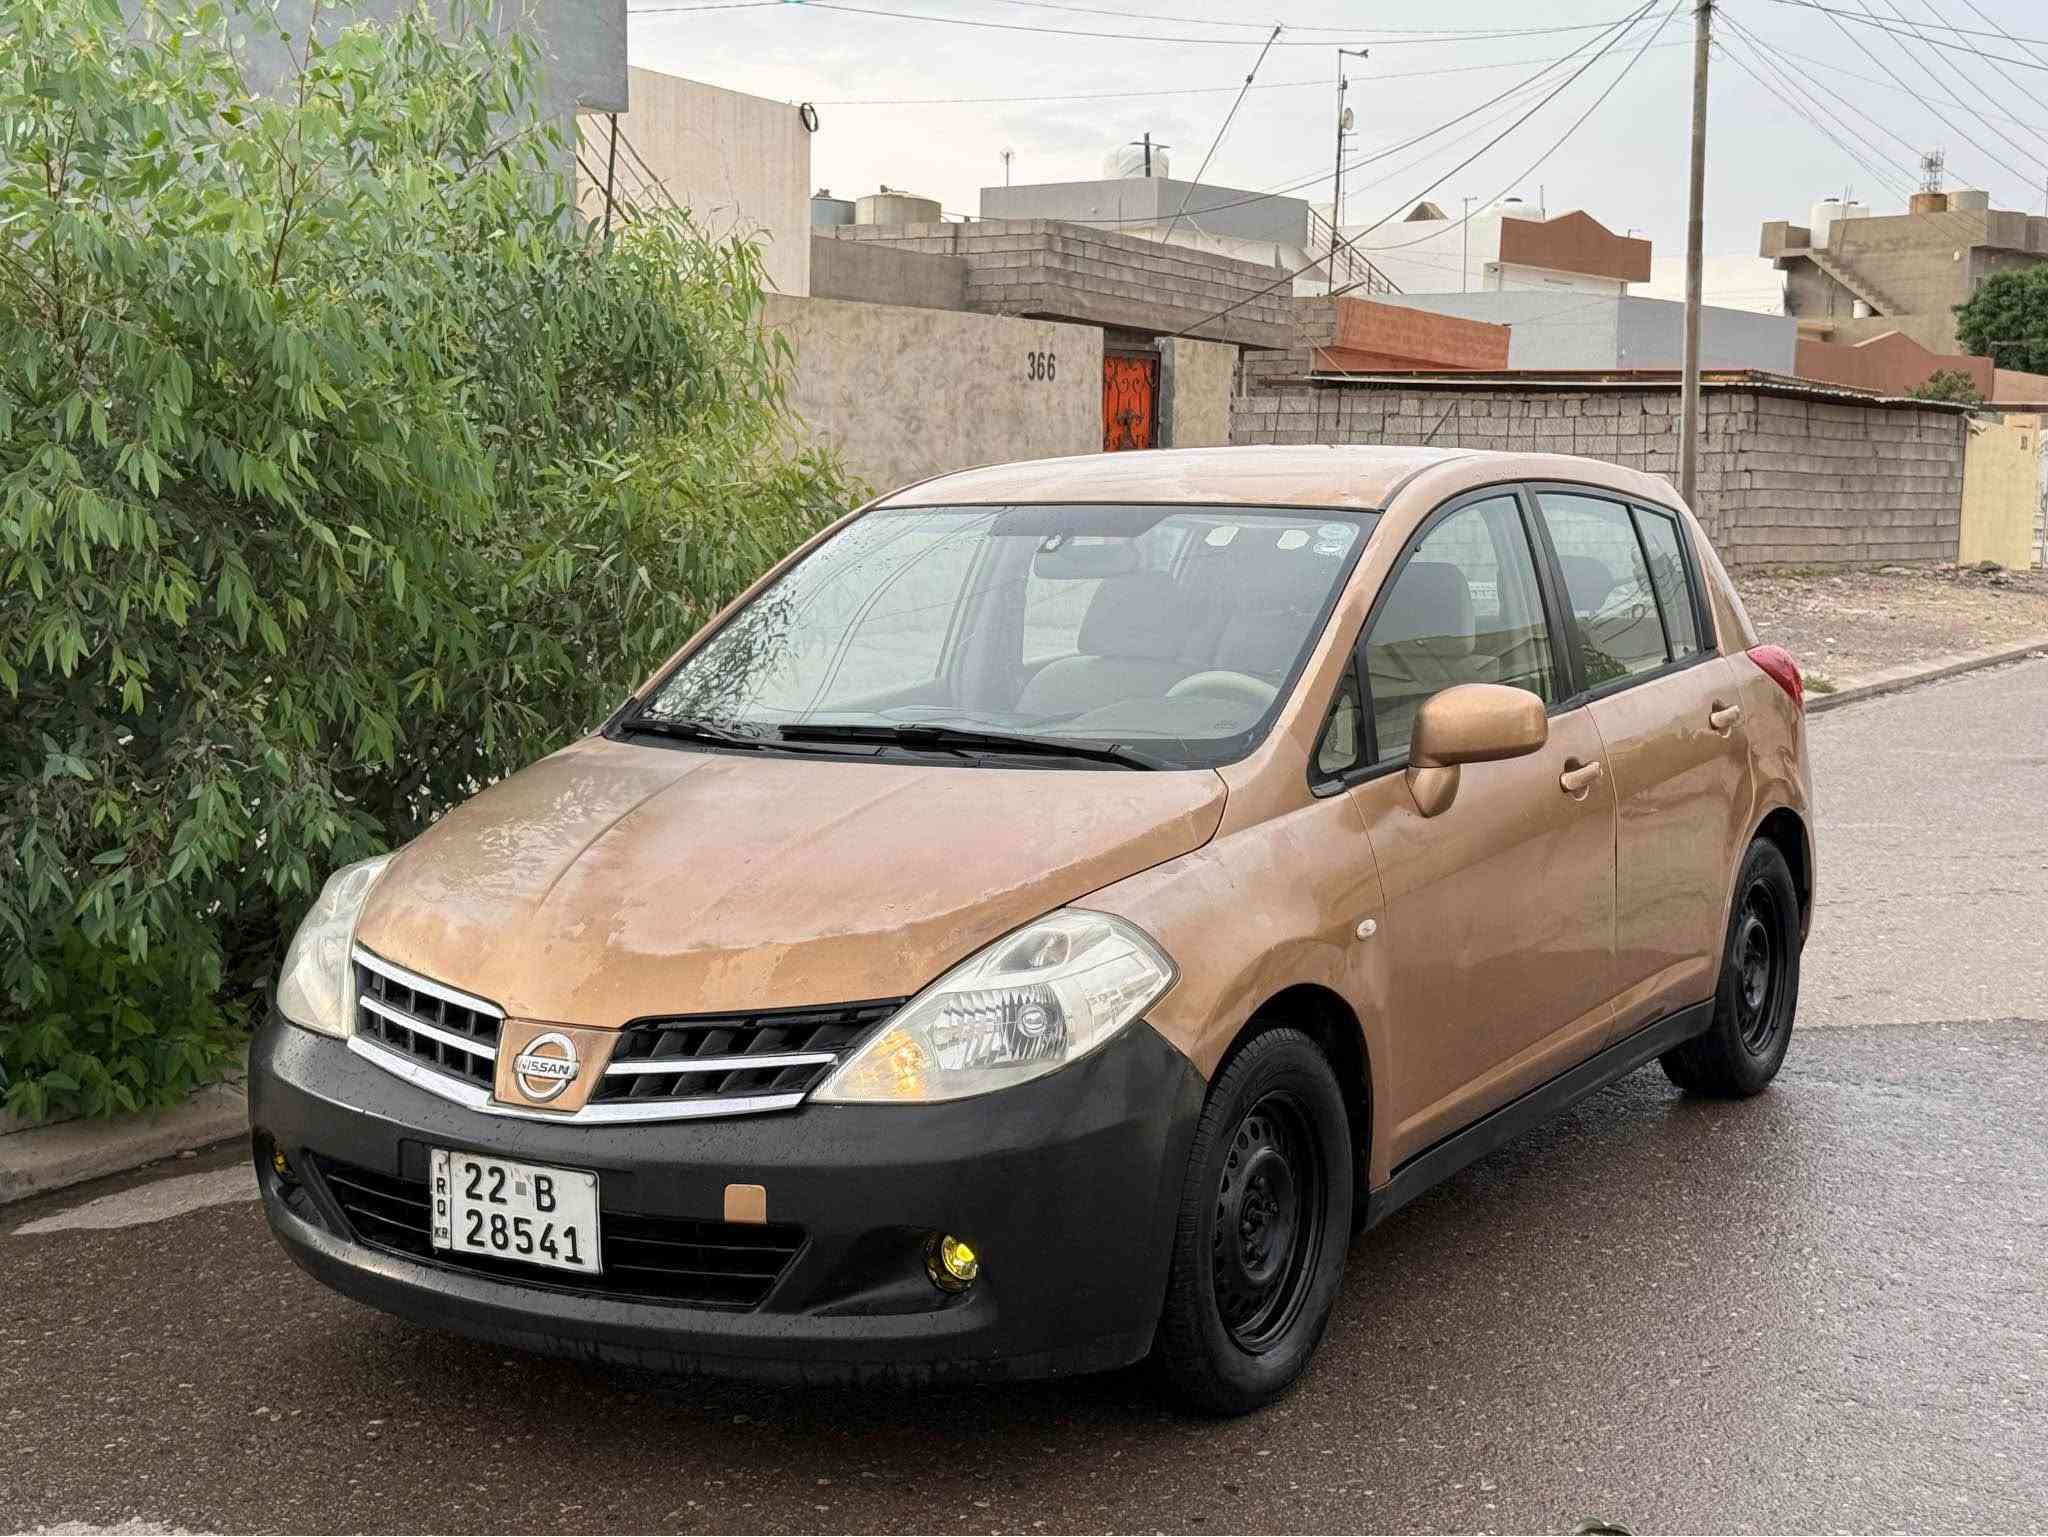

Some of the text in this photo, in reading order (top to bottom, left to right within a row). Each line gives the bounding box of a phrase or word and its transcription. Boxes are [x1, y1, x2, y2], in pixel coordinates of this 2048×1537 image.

[1027, 351, 1056, 381] 366
[519, 1059, 570, 1075] NISSAN
[465, 1162, 556, 1213] 22 B
[466, 1208, 584, 1265] 28541
